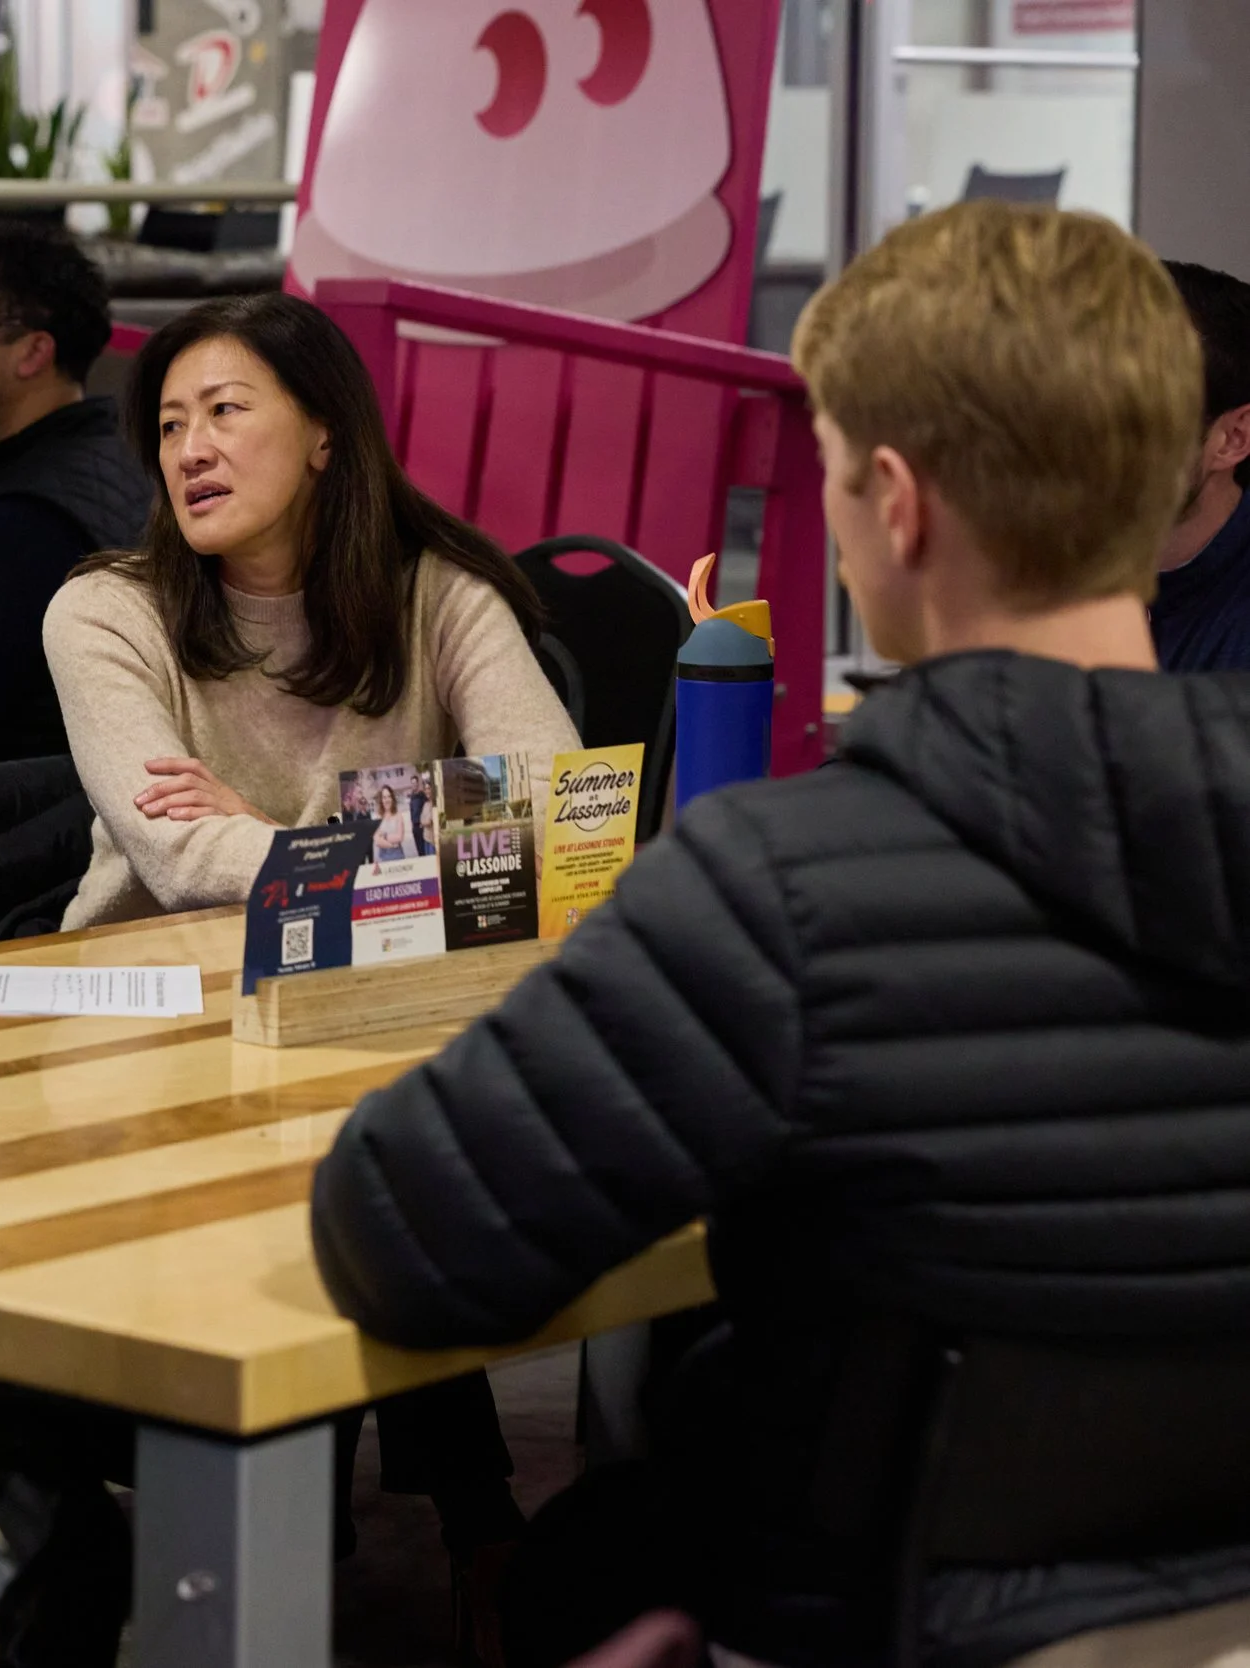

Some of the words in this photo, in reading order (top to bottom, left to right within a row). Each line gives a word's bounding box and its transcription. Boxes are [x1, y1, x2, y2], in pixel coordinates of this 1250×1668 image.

[554, 769, 635, 796] Summer
[554, 796, 631, 823] Lassonde
[457, 829, 511, 859] LIVE
[553, 845, 566, 855] LIVE
[566, 843, 574, 853] AT
[574, 839, 602, 852] LASSONDE
[456, 854, 522, 877] @LASSONDE
[365, 888, 382, 902] LEAD
[382, 886, 390, 899] AT
[391, 882, 423, 898] LASSONDE
